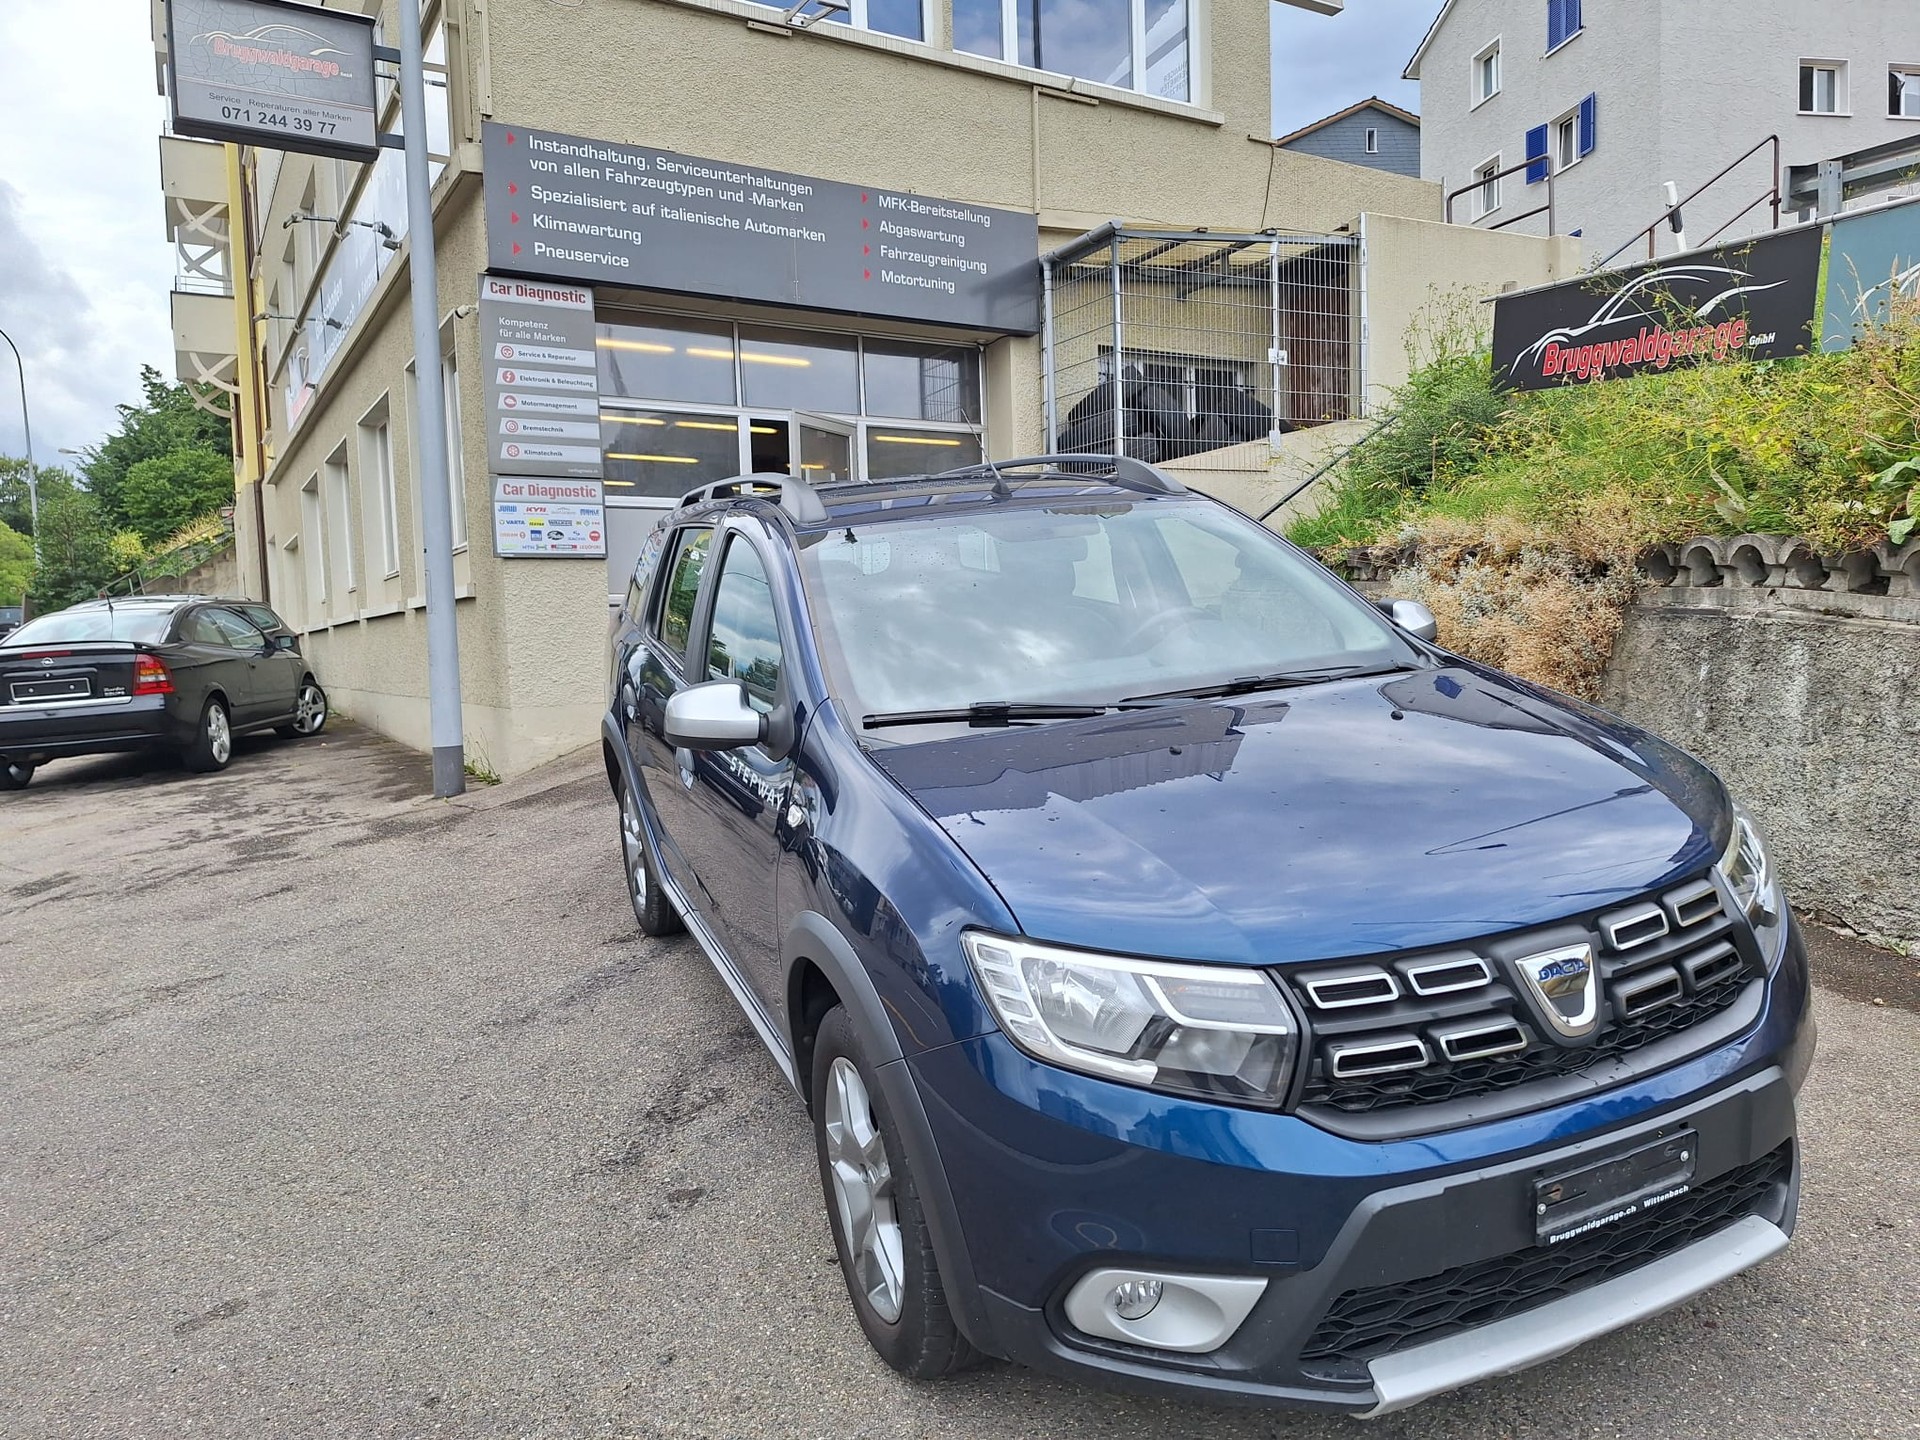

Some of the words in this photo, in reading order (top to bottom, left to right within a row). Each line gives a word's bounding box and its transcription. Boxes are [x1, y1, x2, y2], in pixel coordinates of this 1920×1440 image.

[213, 37, 340, 78] Bruggwaldgarage
[209, 92, 241, 104] Service
[302, 108, 320, 117] aller
[322, 110, 352, 122] Marken
[221, 106, 251, 122] 071
[258, 111, 288, 128] 244
[293, 117, 312, 132] 39
[318, 121, 336, 135] 77
[529, 135, 650, 171] Instandhaltung,
[656, 156, 814, 197] Serviceunterhaltungen
[529, 159, 558, 173] von
[564, 161, 600, 180] allen
[605, 168, 714, 200] Fahrzeugtypen
[719, 187, 744, 203] und
[748, 193, 804, 213] -Marken
[531, 185, 628, 213] Spezialisiert
[632, 198, 656, 216] auf
[660, 204, 740, 231] italienische
[744, 217, 826, 243] Automarken
[878, 195, 991, 227] MFK-Bereitstellung
[532, 213, 642, 245] Klimawartung
[879, 220, 965, 247] Abgaswartung
[534, 242, 630, 268] Pneuservice
[880, 245, 987, 275] Fahrzeugreinigung
[490, 281, 512, 295] Car
[516, 284, 586, 304] Diagnostic
[881, 270, 955, 294] Motortuning
[498, 317, 549, 330] Kompetenz
[499, 328, 512, 338] für
[515, 330, 531, 339] alle
[533, 332, 567, 343] Marken
[518, 350, 541, 358] Service
[548, 353, 576, 361] Reparatur
[1542, 320, 1747, 379] Bruggwaldgarage
[1749, 332, 1776, 345] GmbH
[520, 375, 551, 384] Elektronik
[557, 378, 593, 388] Beleuchtung
[521, 400, 578, 410] Motormanagement
[522, 425, 564, 433] Bremstechnik
[524, 449, 563, 457] Klimatechnik
[503, 483, 525, 496] Car
[527, 484, 597, 500] Diagnostic
[730, 756, 784, 811] STEPWAY
[1538, 957, 1589, 982] DACIA
[1550, 1205, 1637, 1244] Bruggwaldgarage.ch
[1643, 1184, 1689, 1208] Wittenbach
